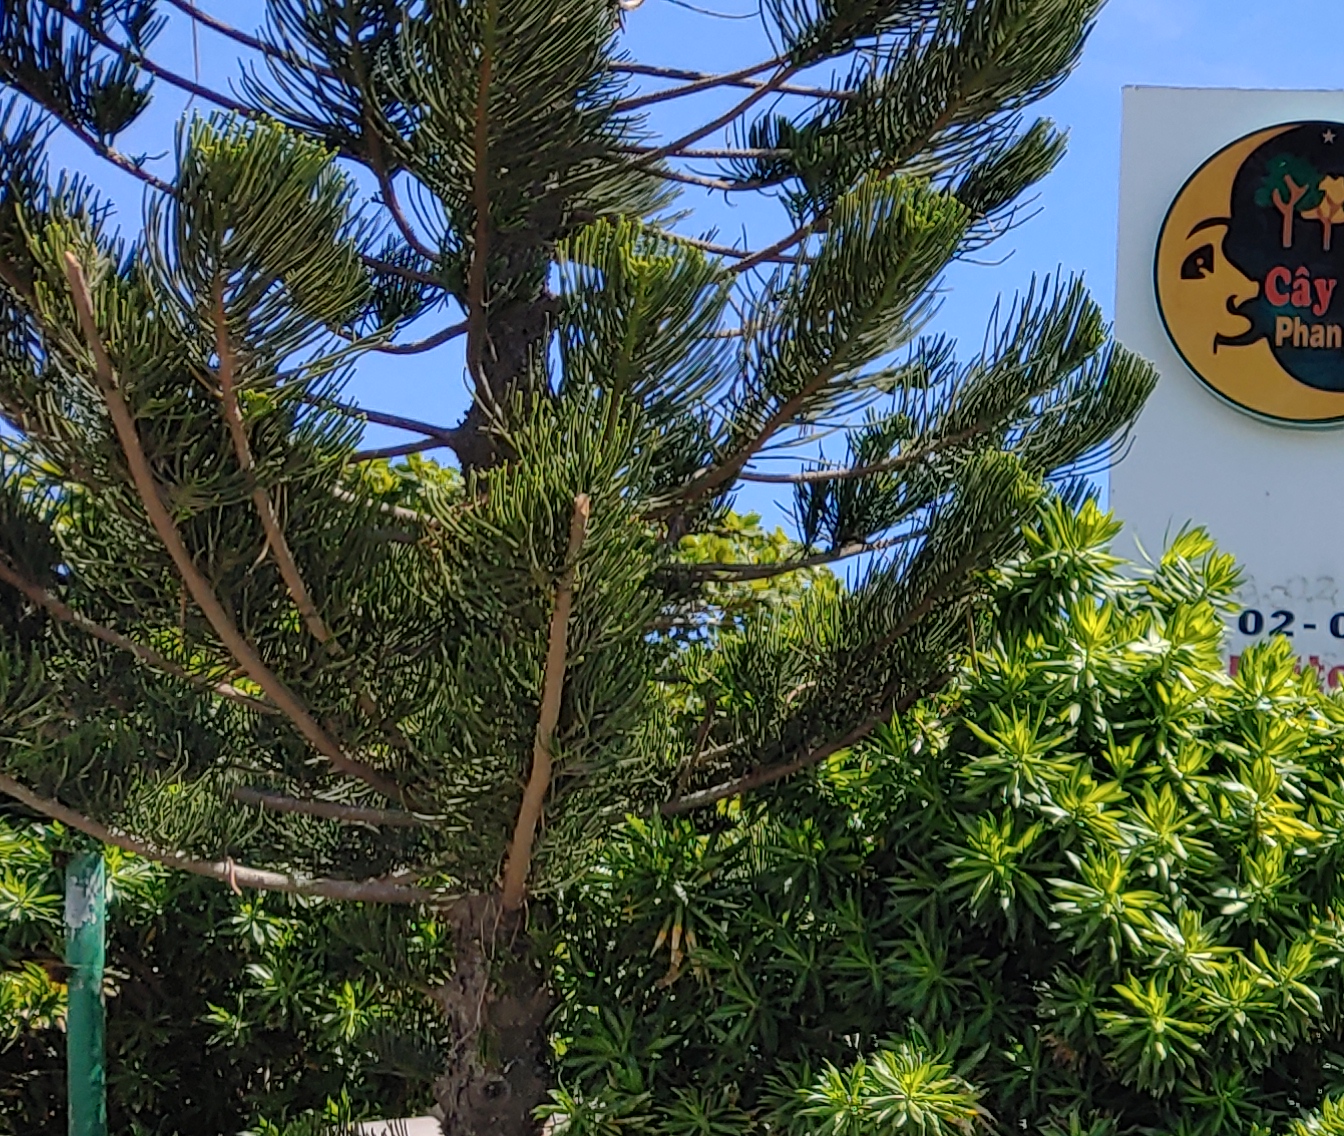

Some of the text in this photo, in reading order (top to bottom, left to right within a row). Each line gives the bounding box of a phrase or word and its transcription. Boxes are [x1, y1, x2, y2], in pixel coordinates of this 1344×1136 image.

[1264, 266, 1336, 316] Cây
[1275, 316, 1342, 348] Phan
[1238, 609, 1295, 638] 02
